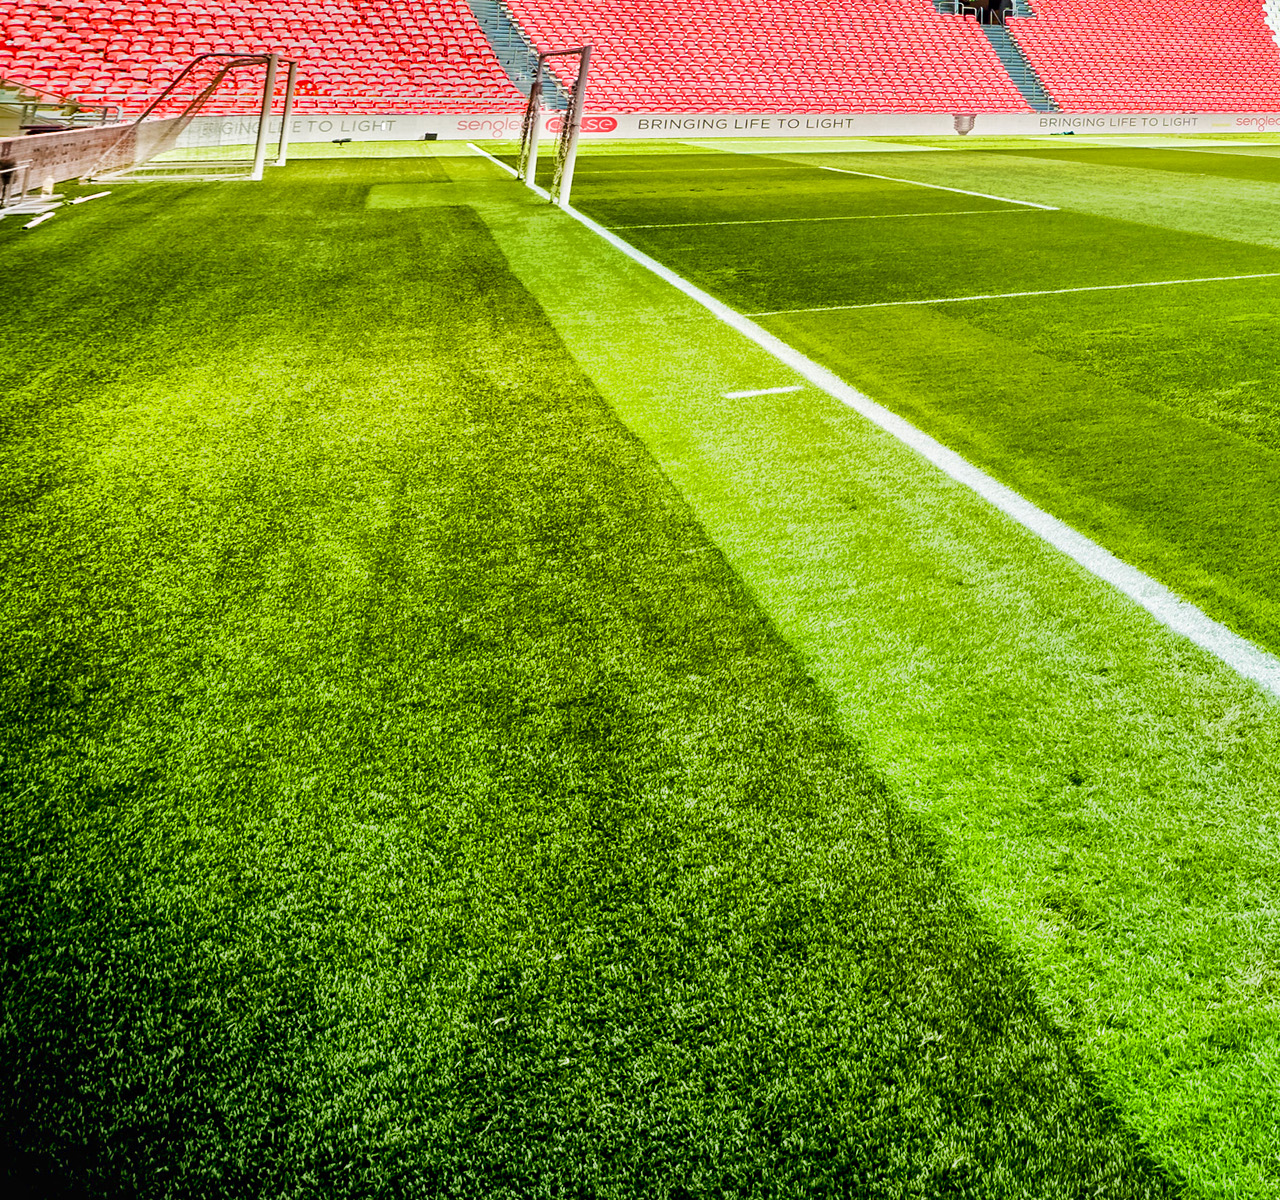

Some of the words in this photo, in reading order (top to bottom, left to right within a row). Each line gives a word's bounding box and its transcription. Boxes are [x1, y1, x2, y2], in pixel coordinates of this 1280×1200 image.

[308, 120, 333, 133] TO
[341, 119, 396, 132] LIGHT
[638, 118, 728, 130] BRINGING
[734, 118, 770, 130] LIFE
[778, 118, 800, 130] TO
[806, 118, 854, 130] LIGHT
[1039, 117, 1105, 128] BRINGING
[1109, 117, 1136, 128] LIFE
[1141, 117, 1159, 128] TO
[1162, 117, 1198, 128] LIGHT
